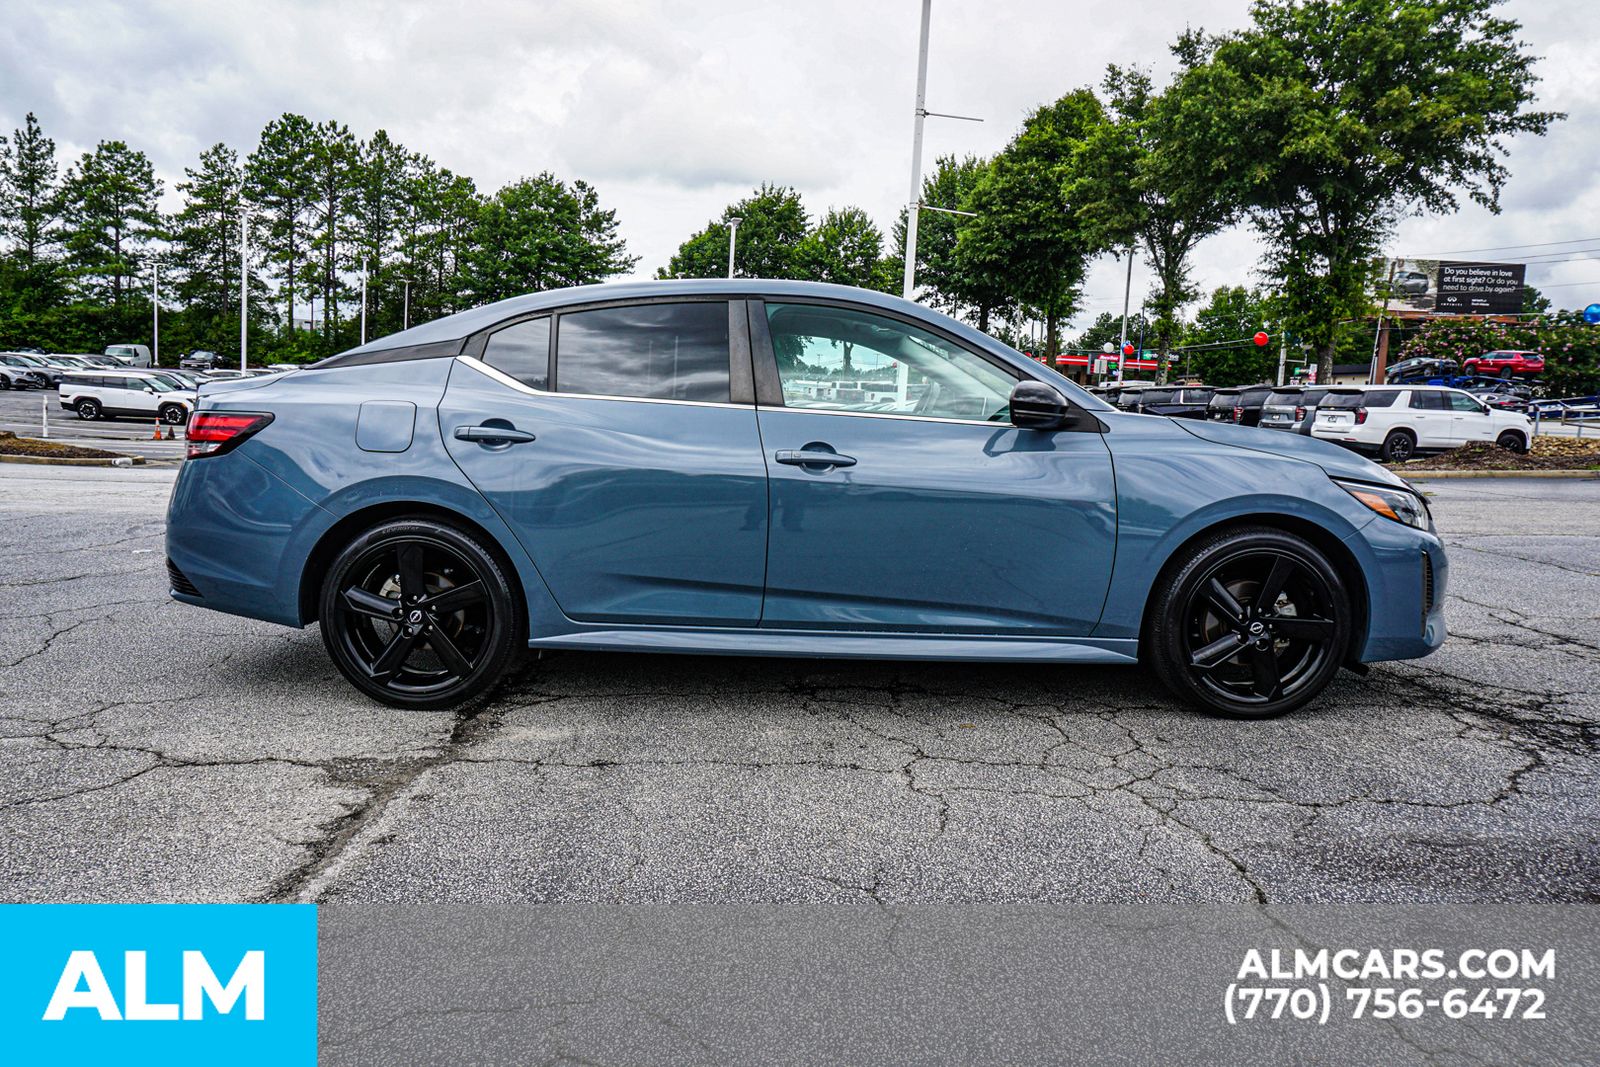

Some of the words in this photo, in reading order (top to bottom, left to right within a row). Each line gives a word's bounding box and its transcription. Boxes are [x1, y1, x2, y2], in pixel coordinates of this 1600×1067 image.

[1444, 267, 1454, 275] Do
[1455, 268, 1468, 276] you
[1468, 267, 1491, 276] believe
[1499, 269, 1513, 277] love
[1451, 275, 1466, 283] first
[1466, 276, 1486, 285] sight?
[1496, 277, 1505, 285] do
[1506, 279, 1518, 287] you
[1468, 284, 1484, 292] drive
[1485, 285, 1493, 293] by
[1494, 286, 1516, 294] again?
